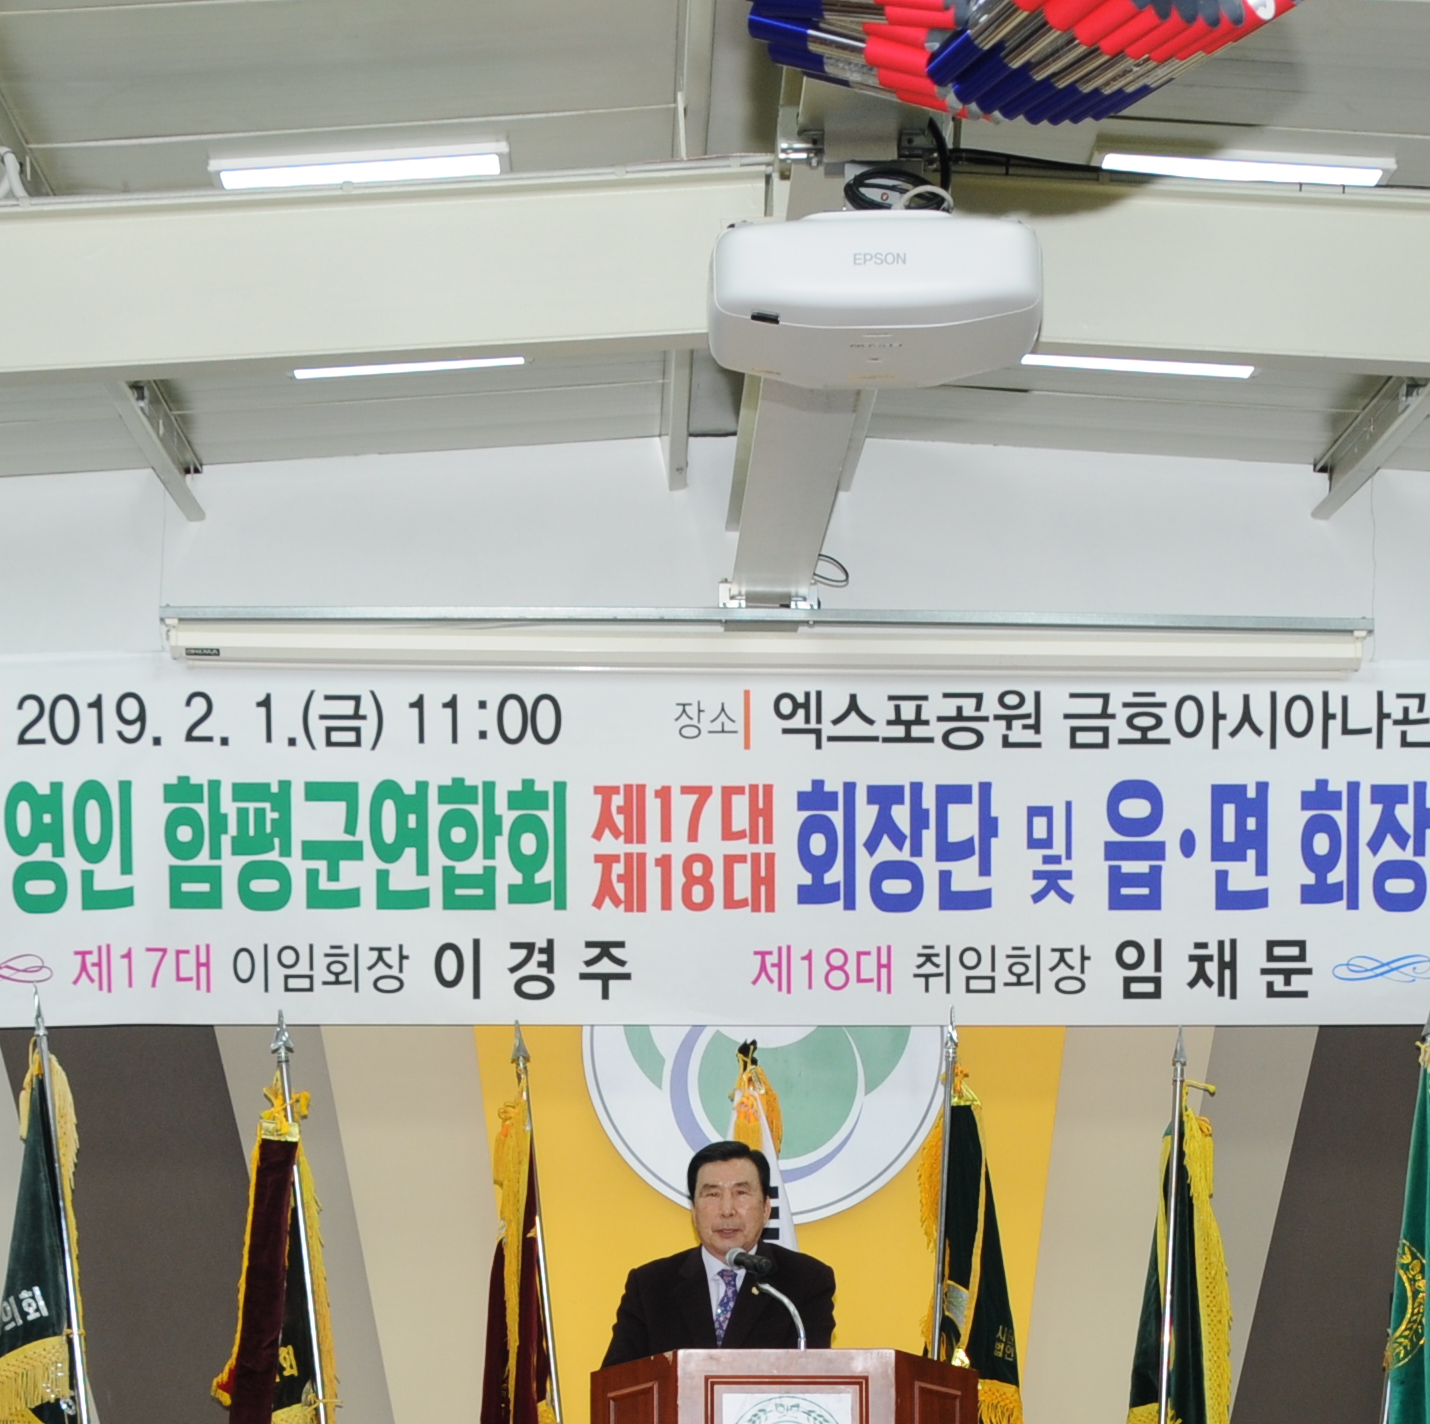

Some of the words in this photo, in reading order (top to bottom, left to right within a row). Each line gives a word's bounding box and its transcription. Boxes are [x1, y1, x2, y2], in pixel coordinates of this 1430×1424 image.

[853, 251, 907, 266] EPSON
[16, 691, 163, 747] 2019.
[184, 691, 230, 747] 2.
[408, 691, 563, 746] 11:00
[673, 699, 740, 741] 장소
[773, 689, 1043, 751] 엑스포공원
[592, 783, 774, 844] 제17대
[163, 776, 567, 915] 함평군연합회
[797, 779, 999, 913] 회장단
[1027, 800, 1075, 905] 및
[592, 852, 775, 913] 제18대
[72, 942, 212, 993] 제17대
[232, 942, 410, 996] 이임회장
[750, 942, 894, 994] 제18대
[912, 942, 1091, 996] 취임회장
